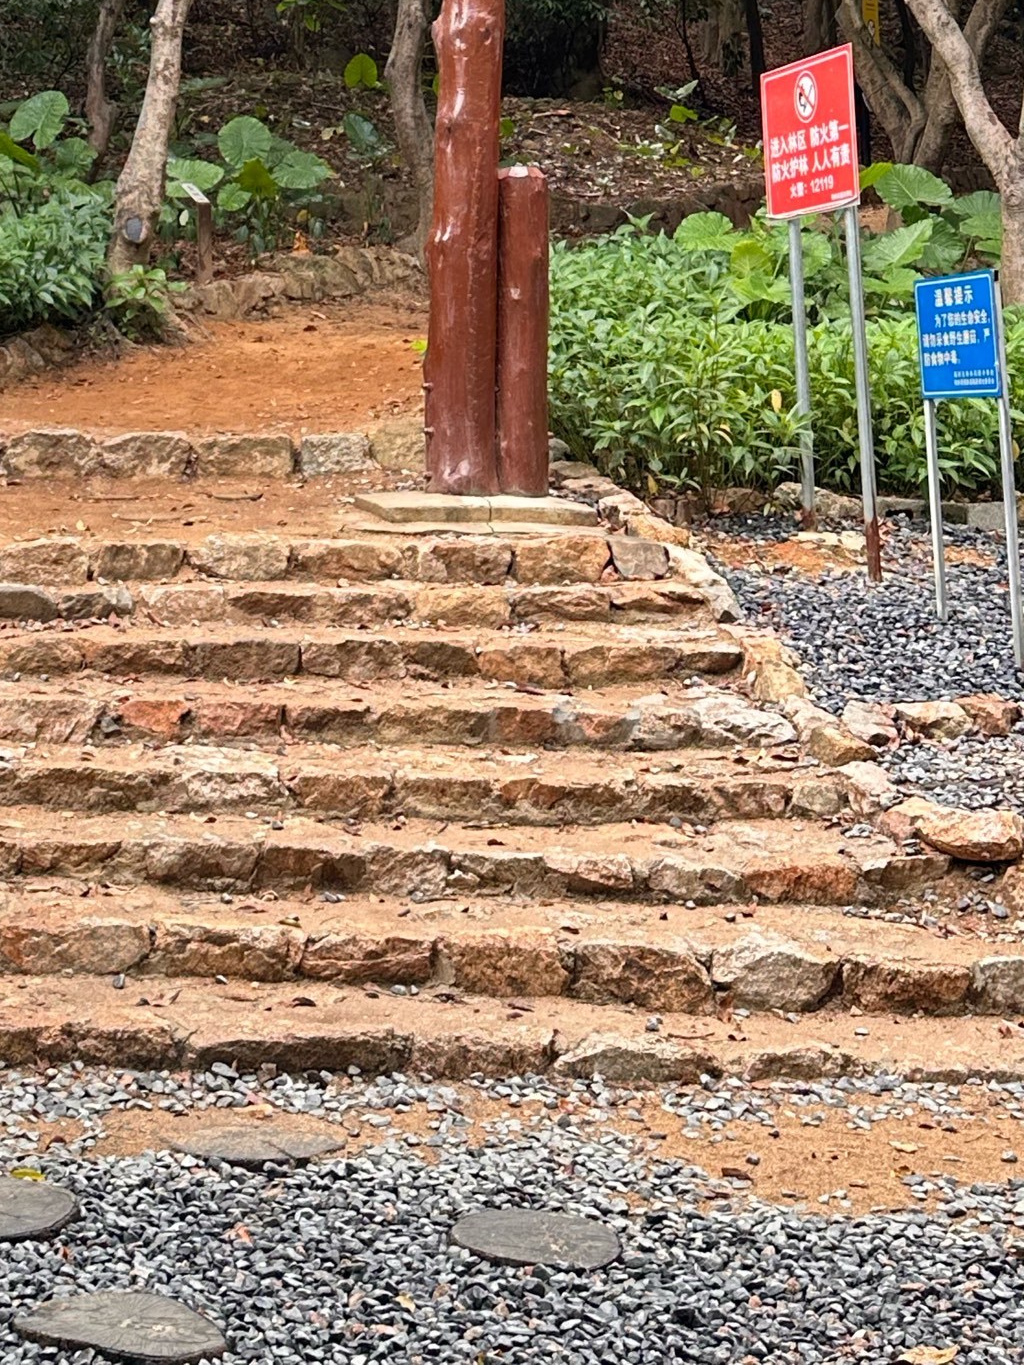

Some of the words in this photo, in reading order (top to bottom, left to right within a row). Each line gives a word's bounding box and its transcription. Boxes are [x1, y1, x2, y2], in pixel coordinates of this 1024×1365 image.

[769, 129, 808, 158] 进入林区
[809, 119, 849, 147] 防火第一
[771, 153, 809, 184] 防火护林
[812, 142, 851, 173] 人人有责
[934, 284, 974, 308] 温馨提示
